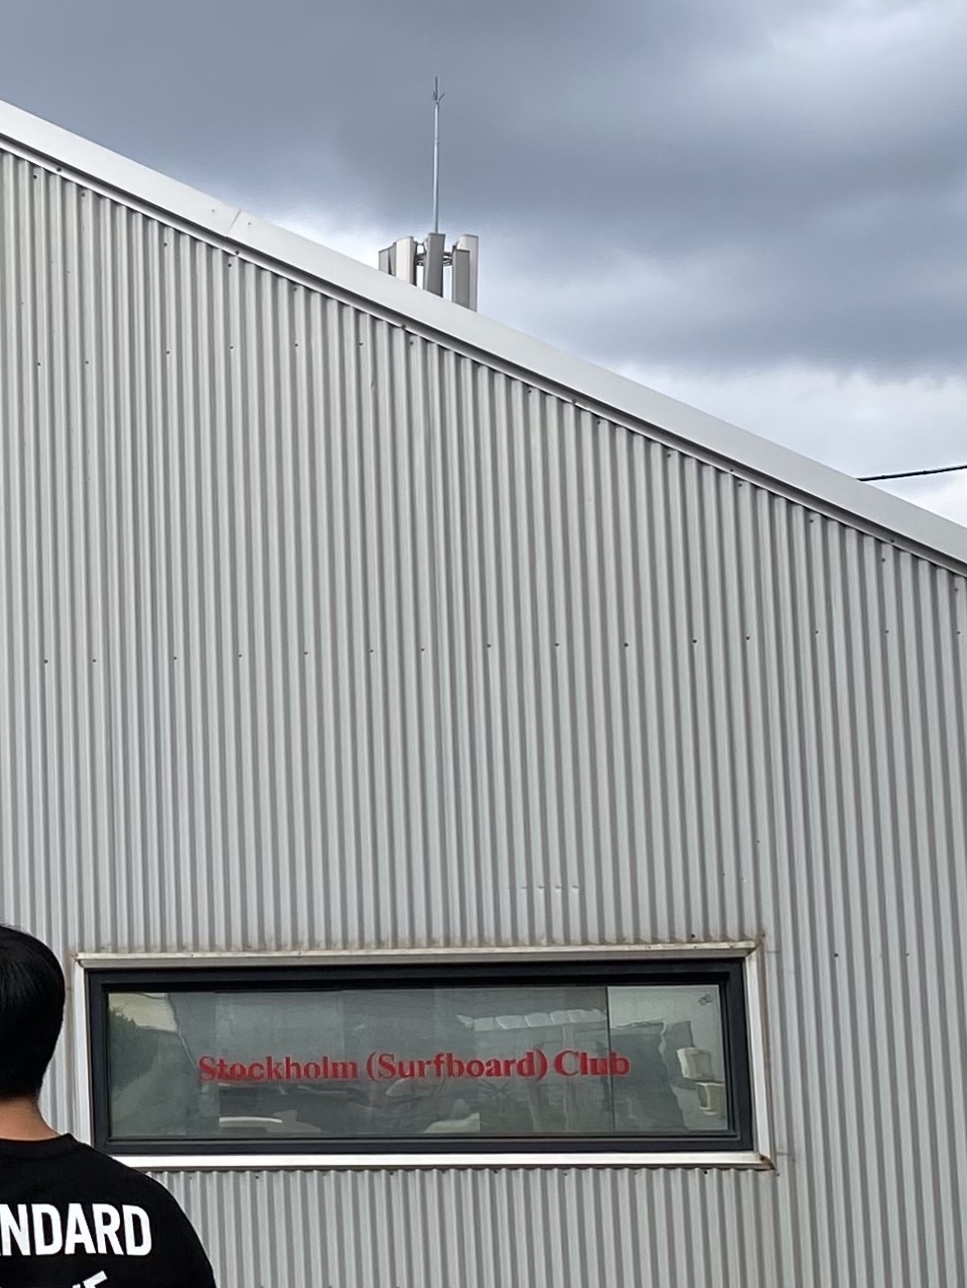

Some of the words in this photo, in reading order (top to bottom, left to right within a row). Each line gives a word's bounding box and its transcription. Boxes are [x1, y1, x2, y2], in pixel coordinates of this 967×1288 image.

[198, 1055, 359, 1081] Stockholm
[366, 1049, 549, 1082] (Surfboard)
[553, 1050, 631, 1076] Club
